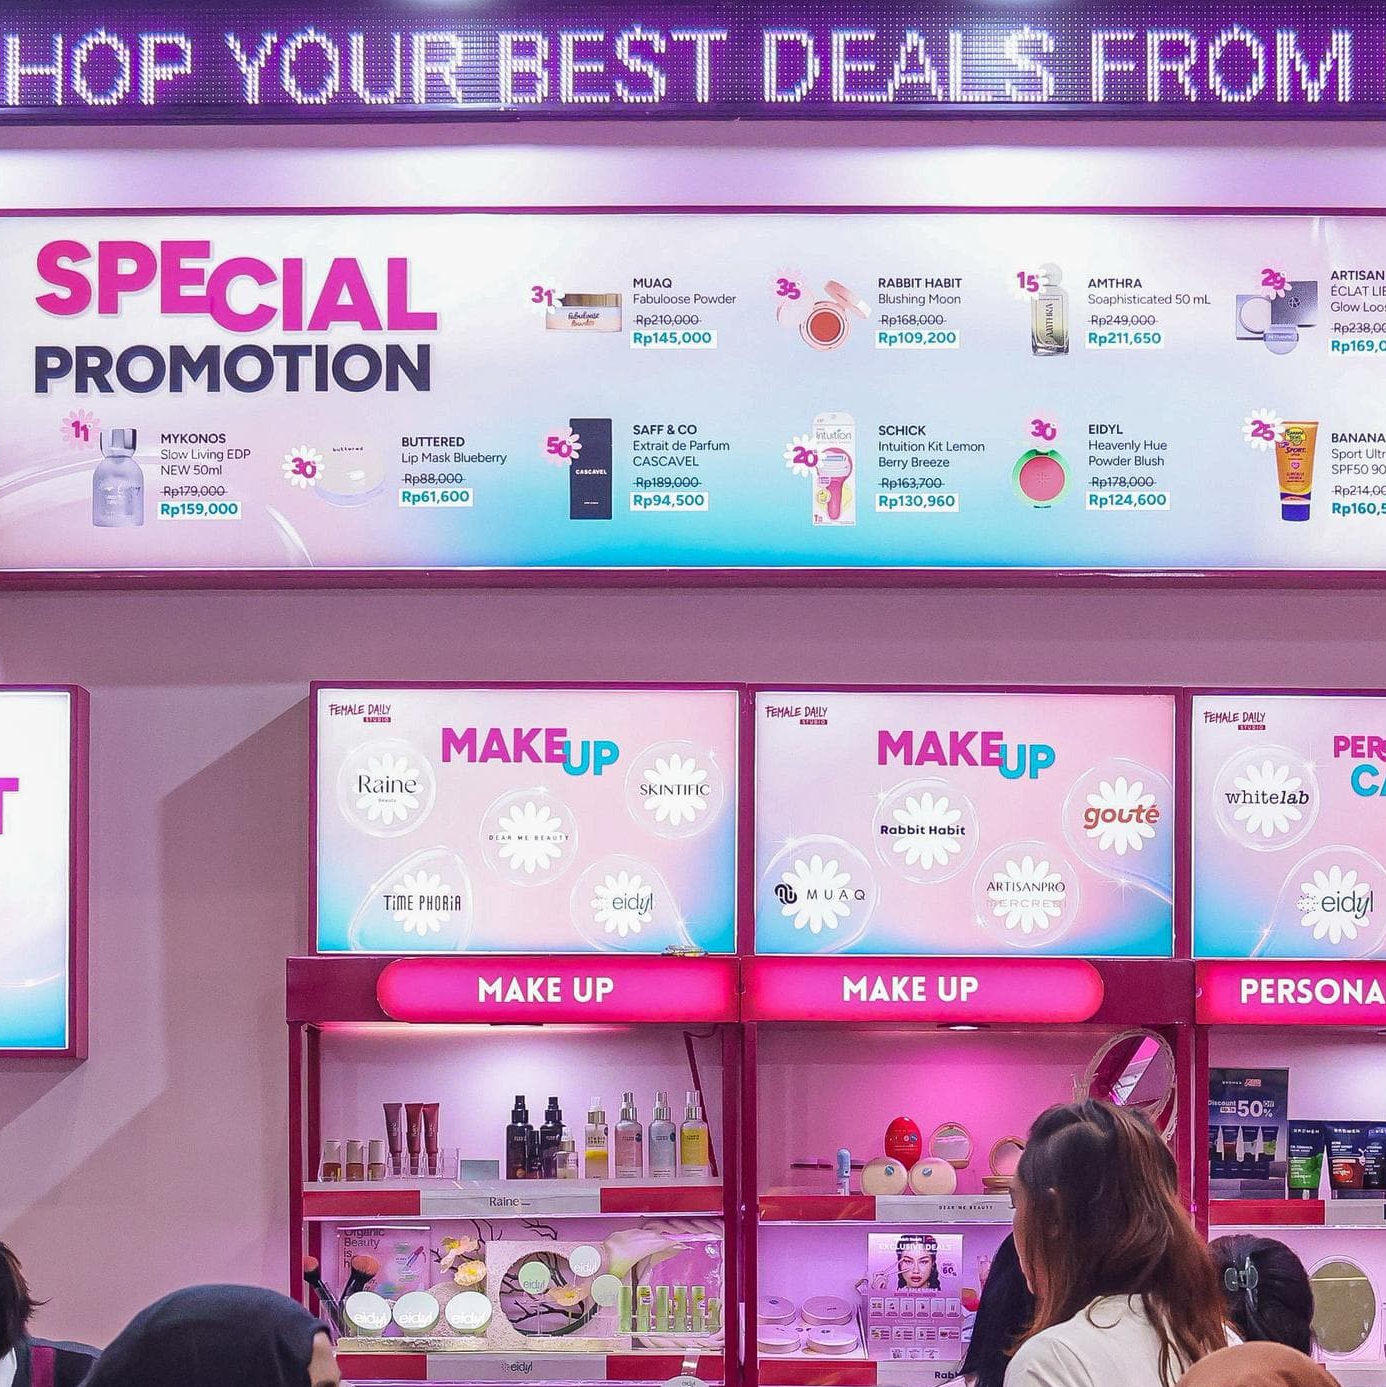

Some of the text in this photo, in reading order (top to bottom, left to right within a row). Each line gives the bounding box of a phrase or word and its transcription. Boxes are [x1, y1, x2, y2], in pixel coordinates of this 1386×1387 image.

[226, 25, 460, 106] YOUR
[498, 25, 728, 105] BEST
[763, 26, 1056, 104] DEALS
[1091, 25, 1352, 103] FROM
[1330, 269, 1385, 281] ARTISAN
[36, 240, 437, 332] SPECIAL
[633, 277, 673, 289] MUAQ
[878, 277, 963, 289] RABBIT HABIT
[1087, 278, 1143, 289] AMTHRA
[633, 293, 737, 305] Fabuloose Powder
[878, 293, 962, 307] Blushing Moon
[1330, 300, 1361, 313] Glow
[633, 331, 712, 347] Rp145,000
[878, 331, 957, 347] Rp109,200
[1088, 331, 1162, 347] Rp211,650
[35, 344, 430, 393] PROMOTION
[632, 424, 698, 436] SAFF & CO
[878, 425, 927, 436] SCHICK
[1088, 423, 1124, 435] EIDYL
[160, 432, 227, 444] MYKONOS
[401, 436, 466, 448] BUTTERED
[1331, 432, 1386, 444] BANANA
[878, 440, 985, 452] Intuition Kit Lemon
[1088, 439, 1168, 453] Heavenly Hue
[401, 451, 508, 466] Lip Mask Blueberry
[632, 455, 700, 467] CASCAVEL
[1088, 455, 1165, 467] Powder Blush
[1331, 447, 1363, 462] Sport
[160, 464, 223, 476] NEW 50ml
[878, 456, 950, 471] Berry Breeze
[1331, 463, 1369, 475] SPF50
[401, 490, 470, 505] Rp61,600
[633, 494, 705, 510] Rp94,500
[878, 494, 956, 510] Rp130,960
[1089, 493, 1167, 509] Rp124,600
[160, 502, 239, 519] Rp159,000
[357, 774, 418, 794] Raine
[639, 783, 710, 796] SKINTIFIC
[1225, 790, 1309, 805] whitelab
[1083, 803, 1160, 830] gouté
[880, 824, 966, 836] Rabbit Habit
[806, 888, 866, 901] MUAQ
[612, 892, 654, 916] eidyl
[1321, 890, 1374, 920] eidyl
[478, 976, 613, 1002] MAKE UP
[842, 975, 978, 1002] MAKE UP
